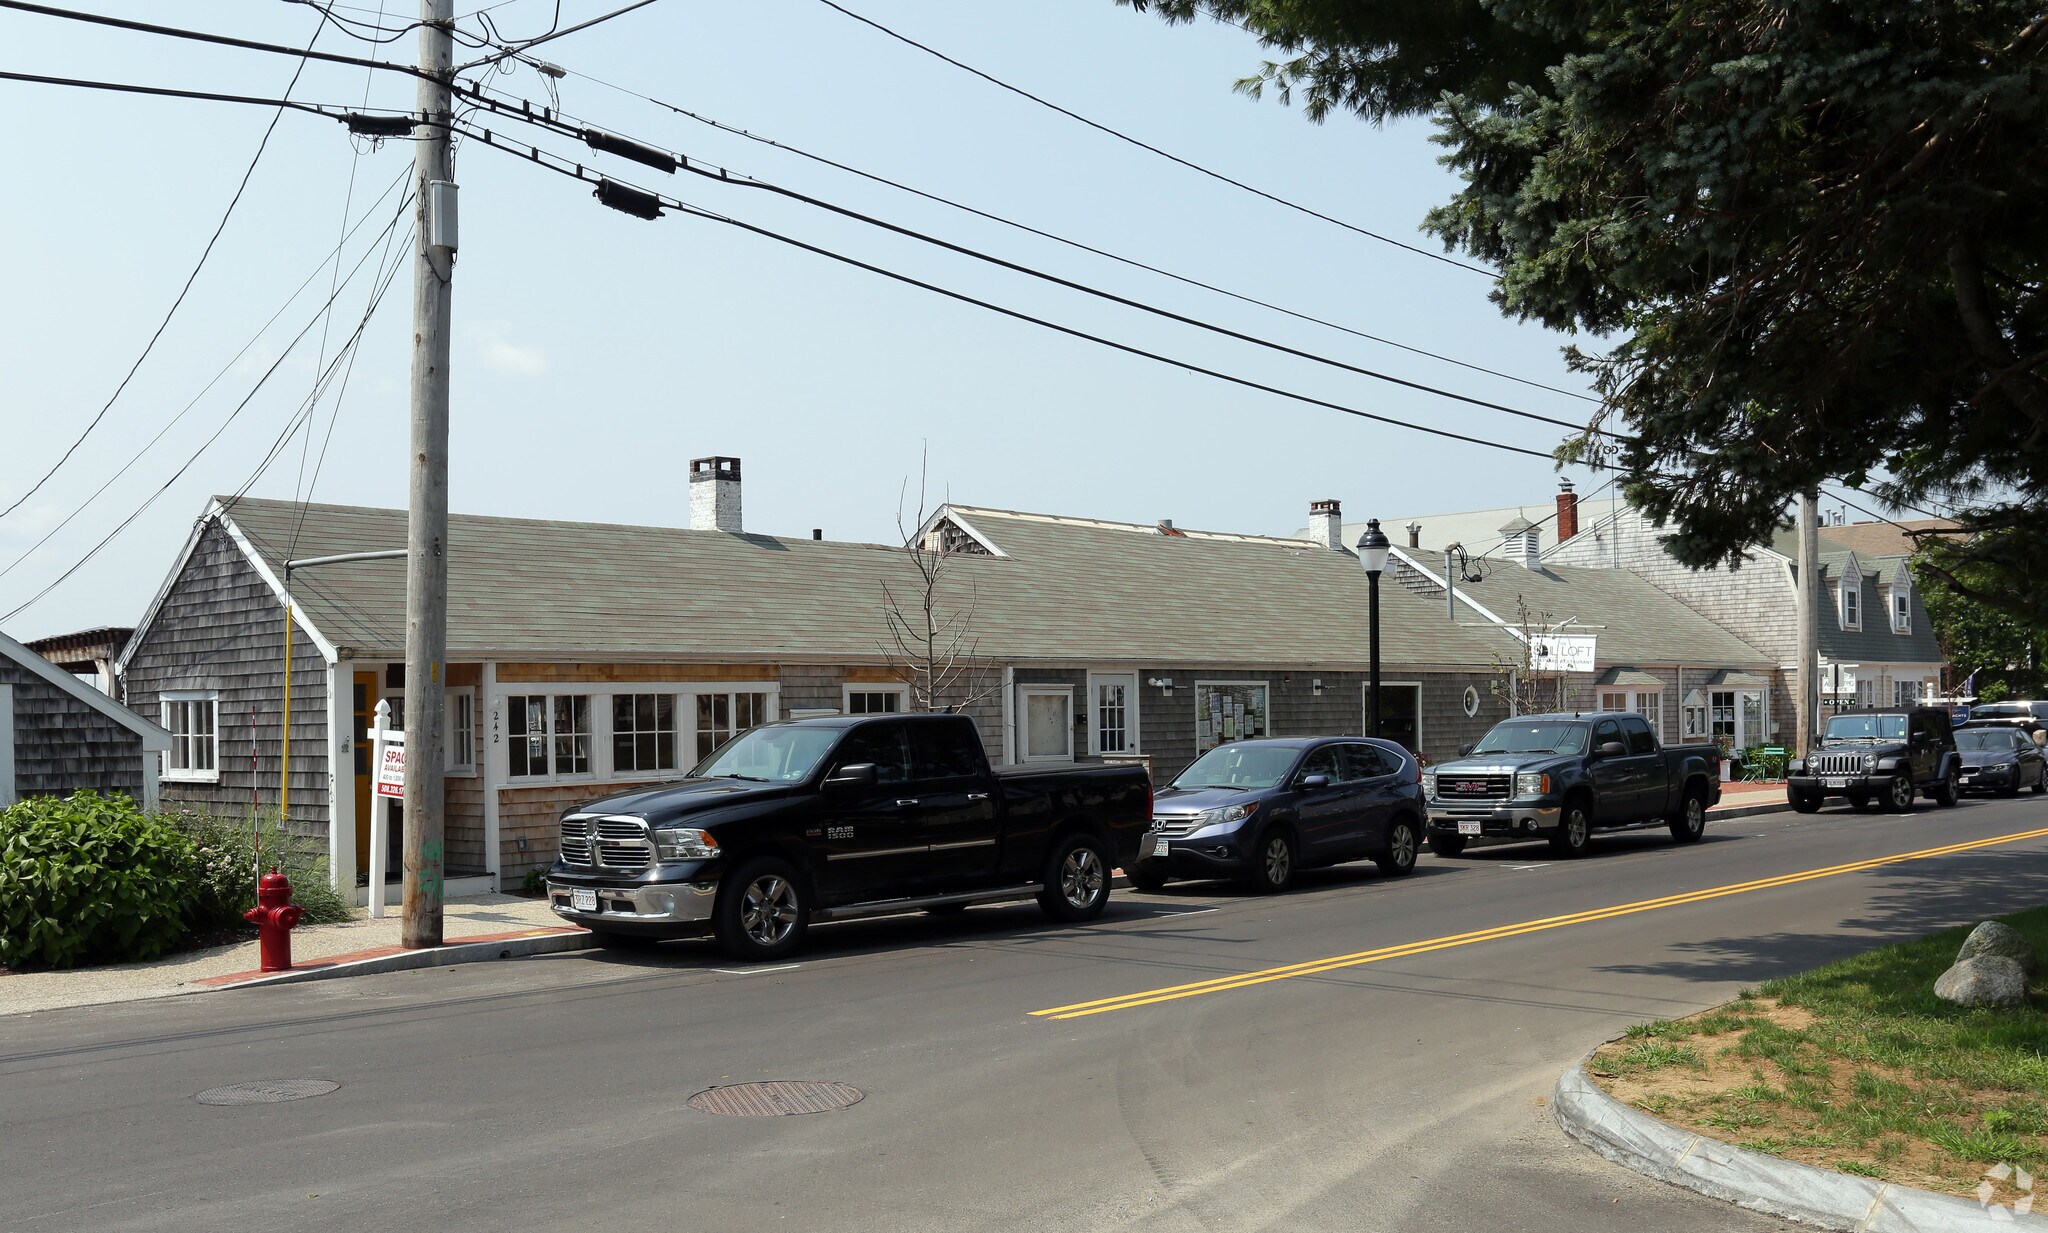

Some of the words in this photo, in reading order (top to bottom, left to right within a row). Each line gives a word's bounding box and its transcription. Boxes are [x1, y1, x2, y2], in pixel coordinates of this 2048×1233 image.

[1561, 646, 1593, 657] LOFT
[1455, 782, 1487, 791] GMC
[828, 826, 854, 834] RAM
